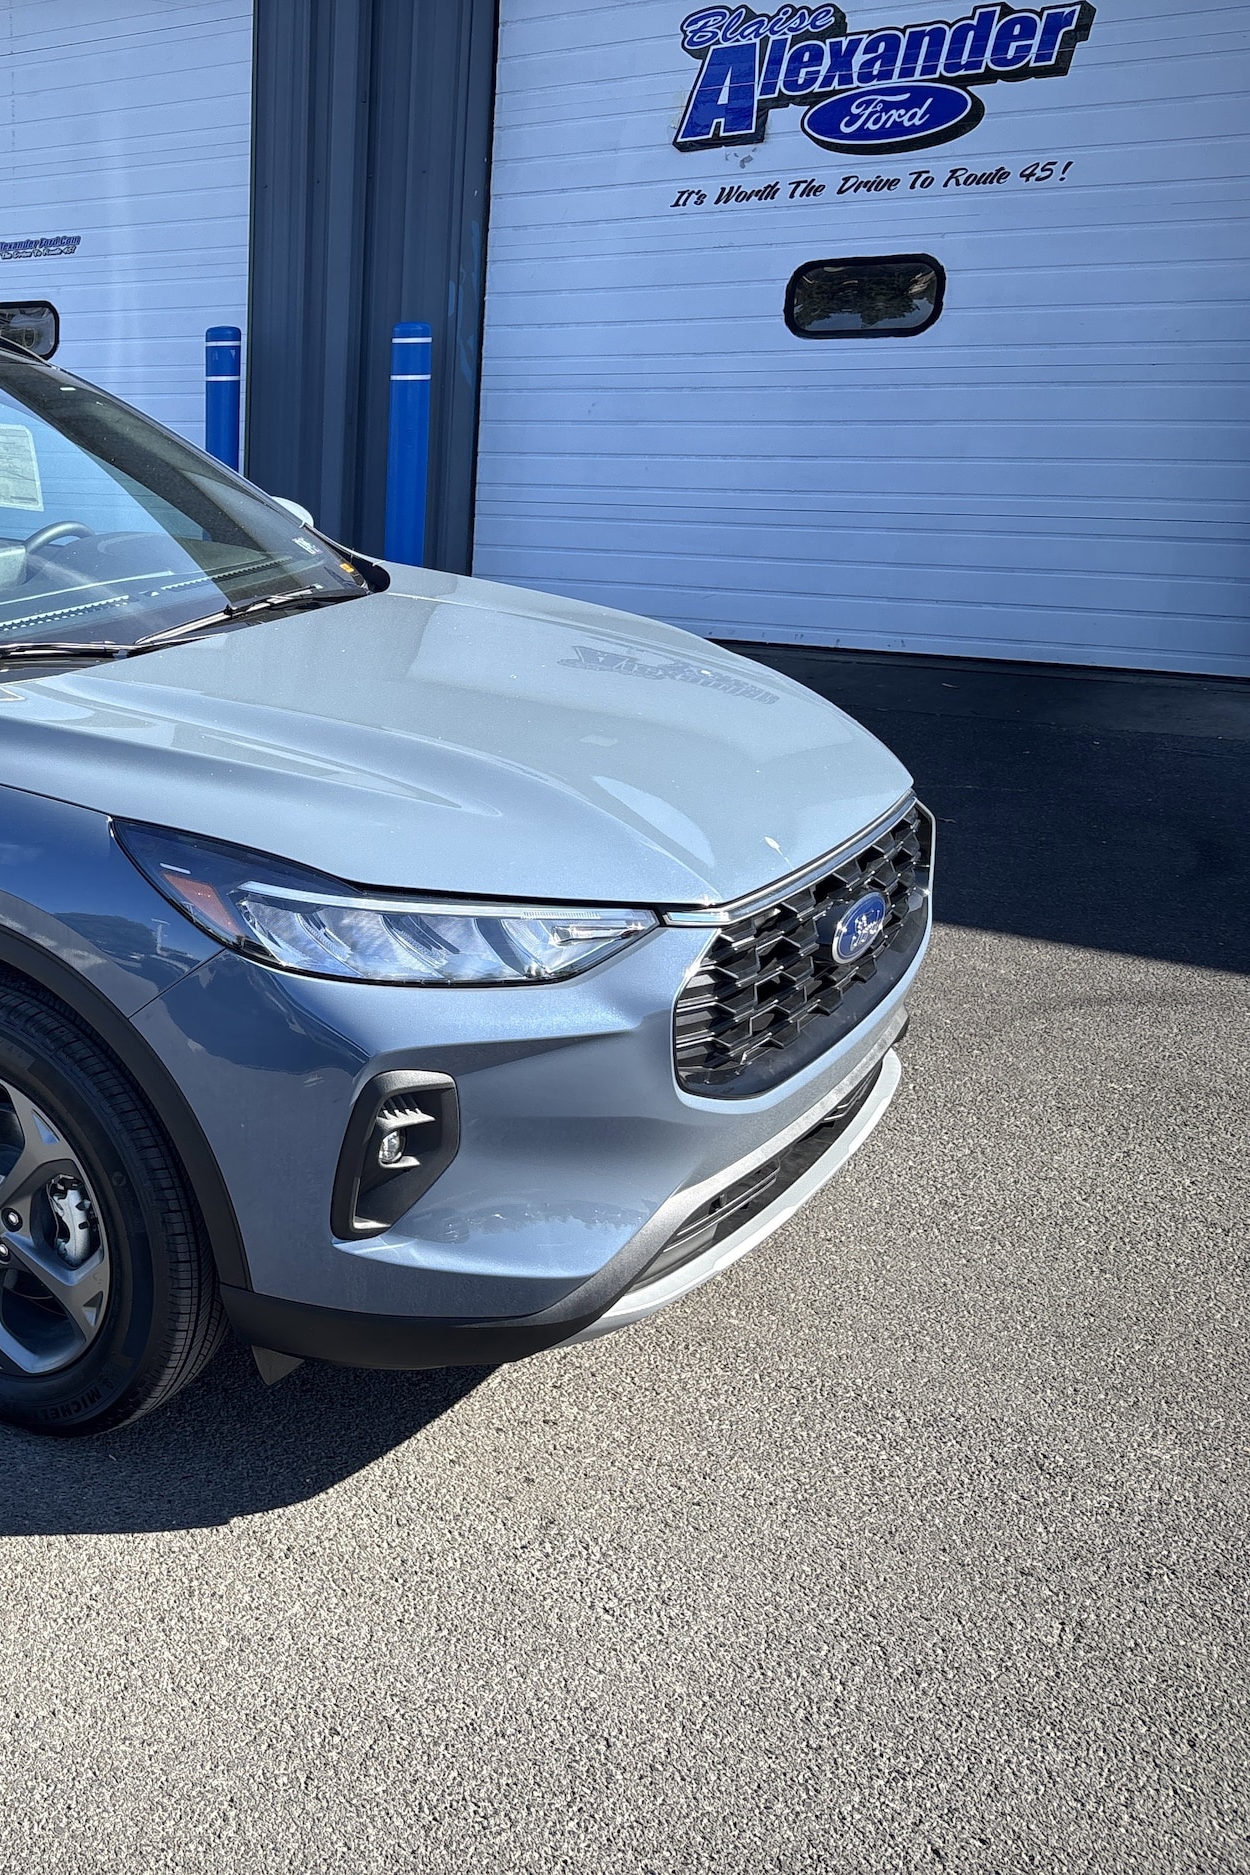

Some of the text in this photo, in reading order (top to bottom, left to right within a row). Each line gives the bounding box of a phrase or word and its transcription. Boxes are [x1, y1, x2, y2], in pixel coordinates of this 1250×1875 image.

[682, 3, 837, 50] Blaise
[675, 1, 1087, 144] Alexander
[838, 93, 931, 132] Ford
[669, 189, 708, 208] It's
[713, 181, 782, 206] Worth
[787, 178, 827, 200] The
[835, 175, 902, 196] Drive
[908, 170, 936, 190] To
[942, 166, 1012, 188] Route
